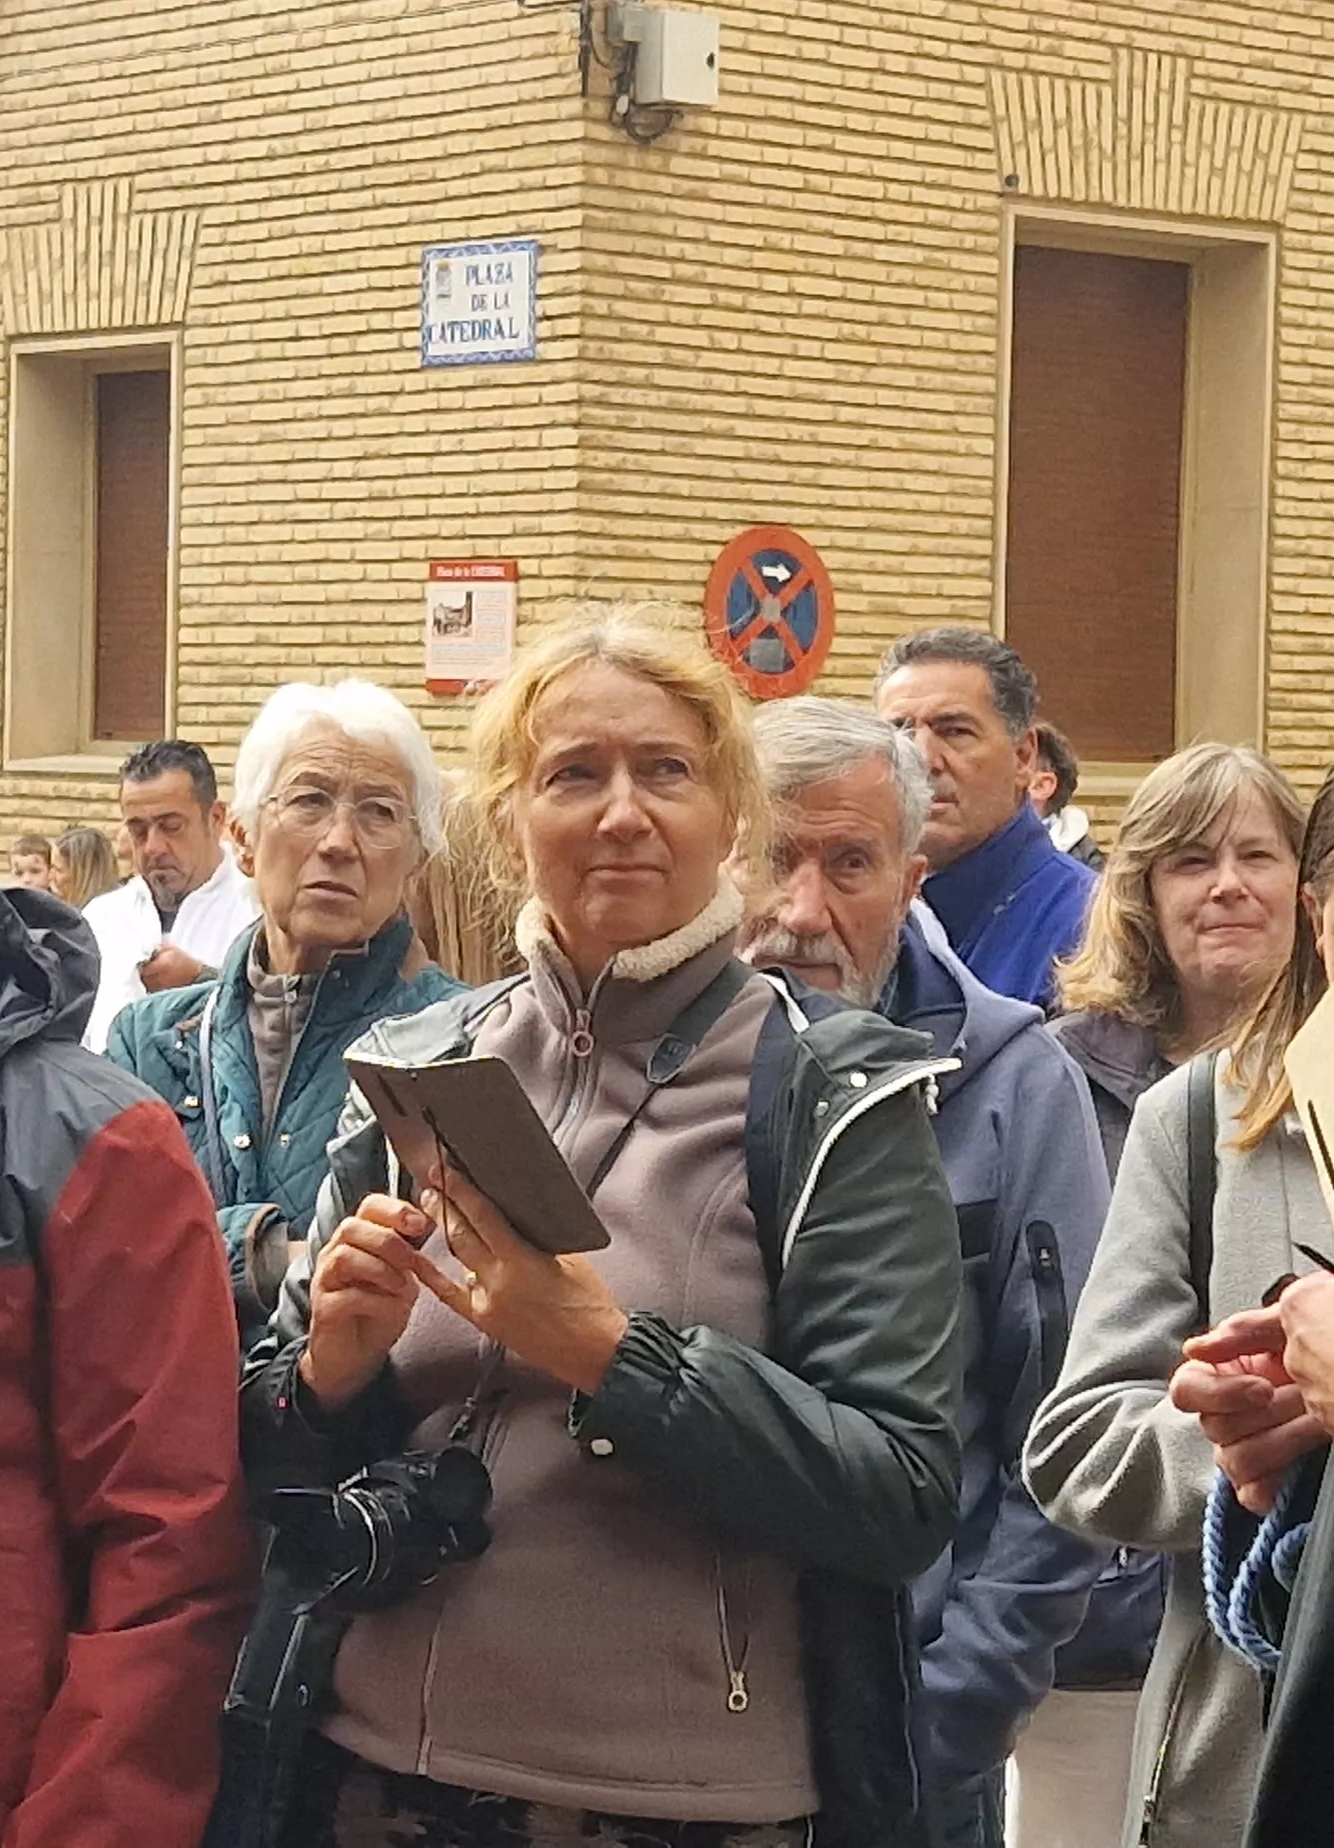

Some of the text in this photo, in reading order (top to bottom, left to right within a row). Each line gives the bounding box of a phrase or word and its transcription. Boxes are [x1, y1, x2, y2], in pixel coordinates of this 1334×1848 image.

[466, 262, 513, 287] PLAZA
[471, 291, 510, 312] DE LA
